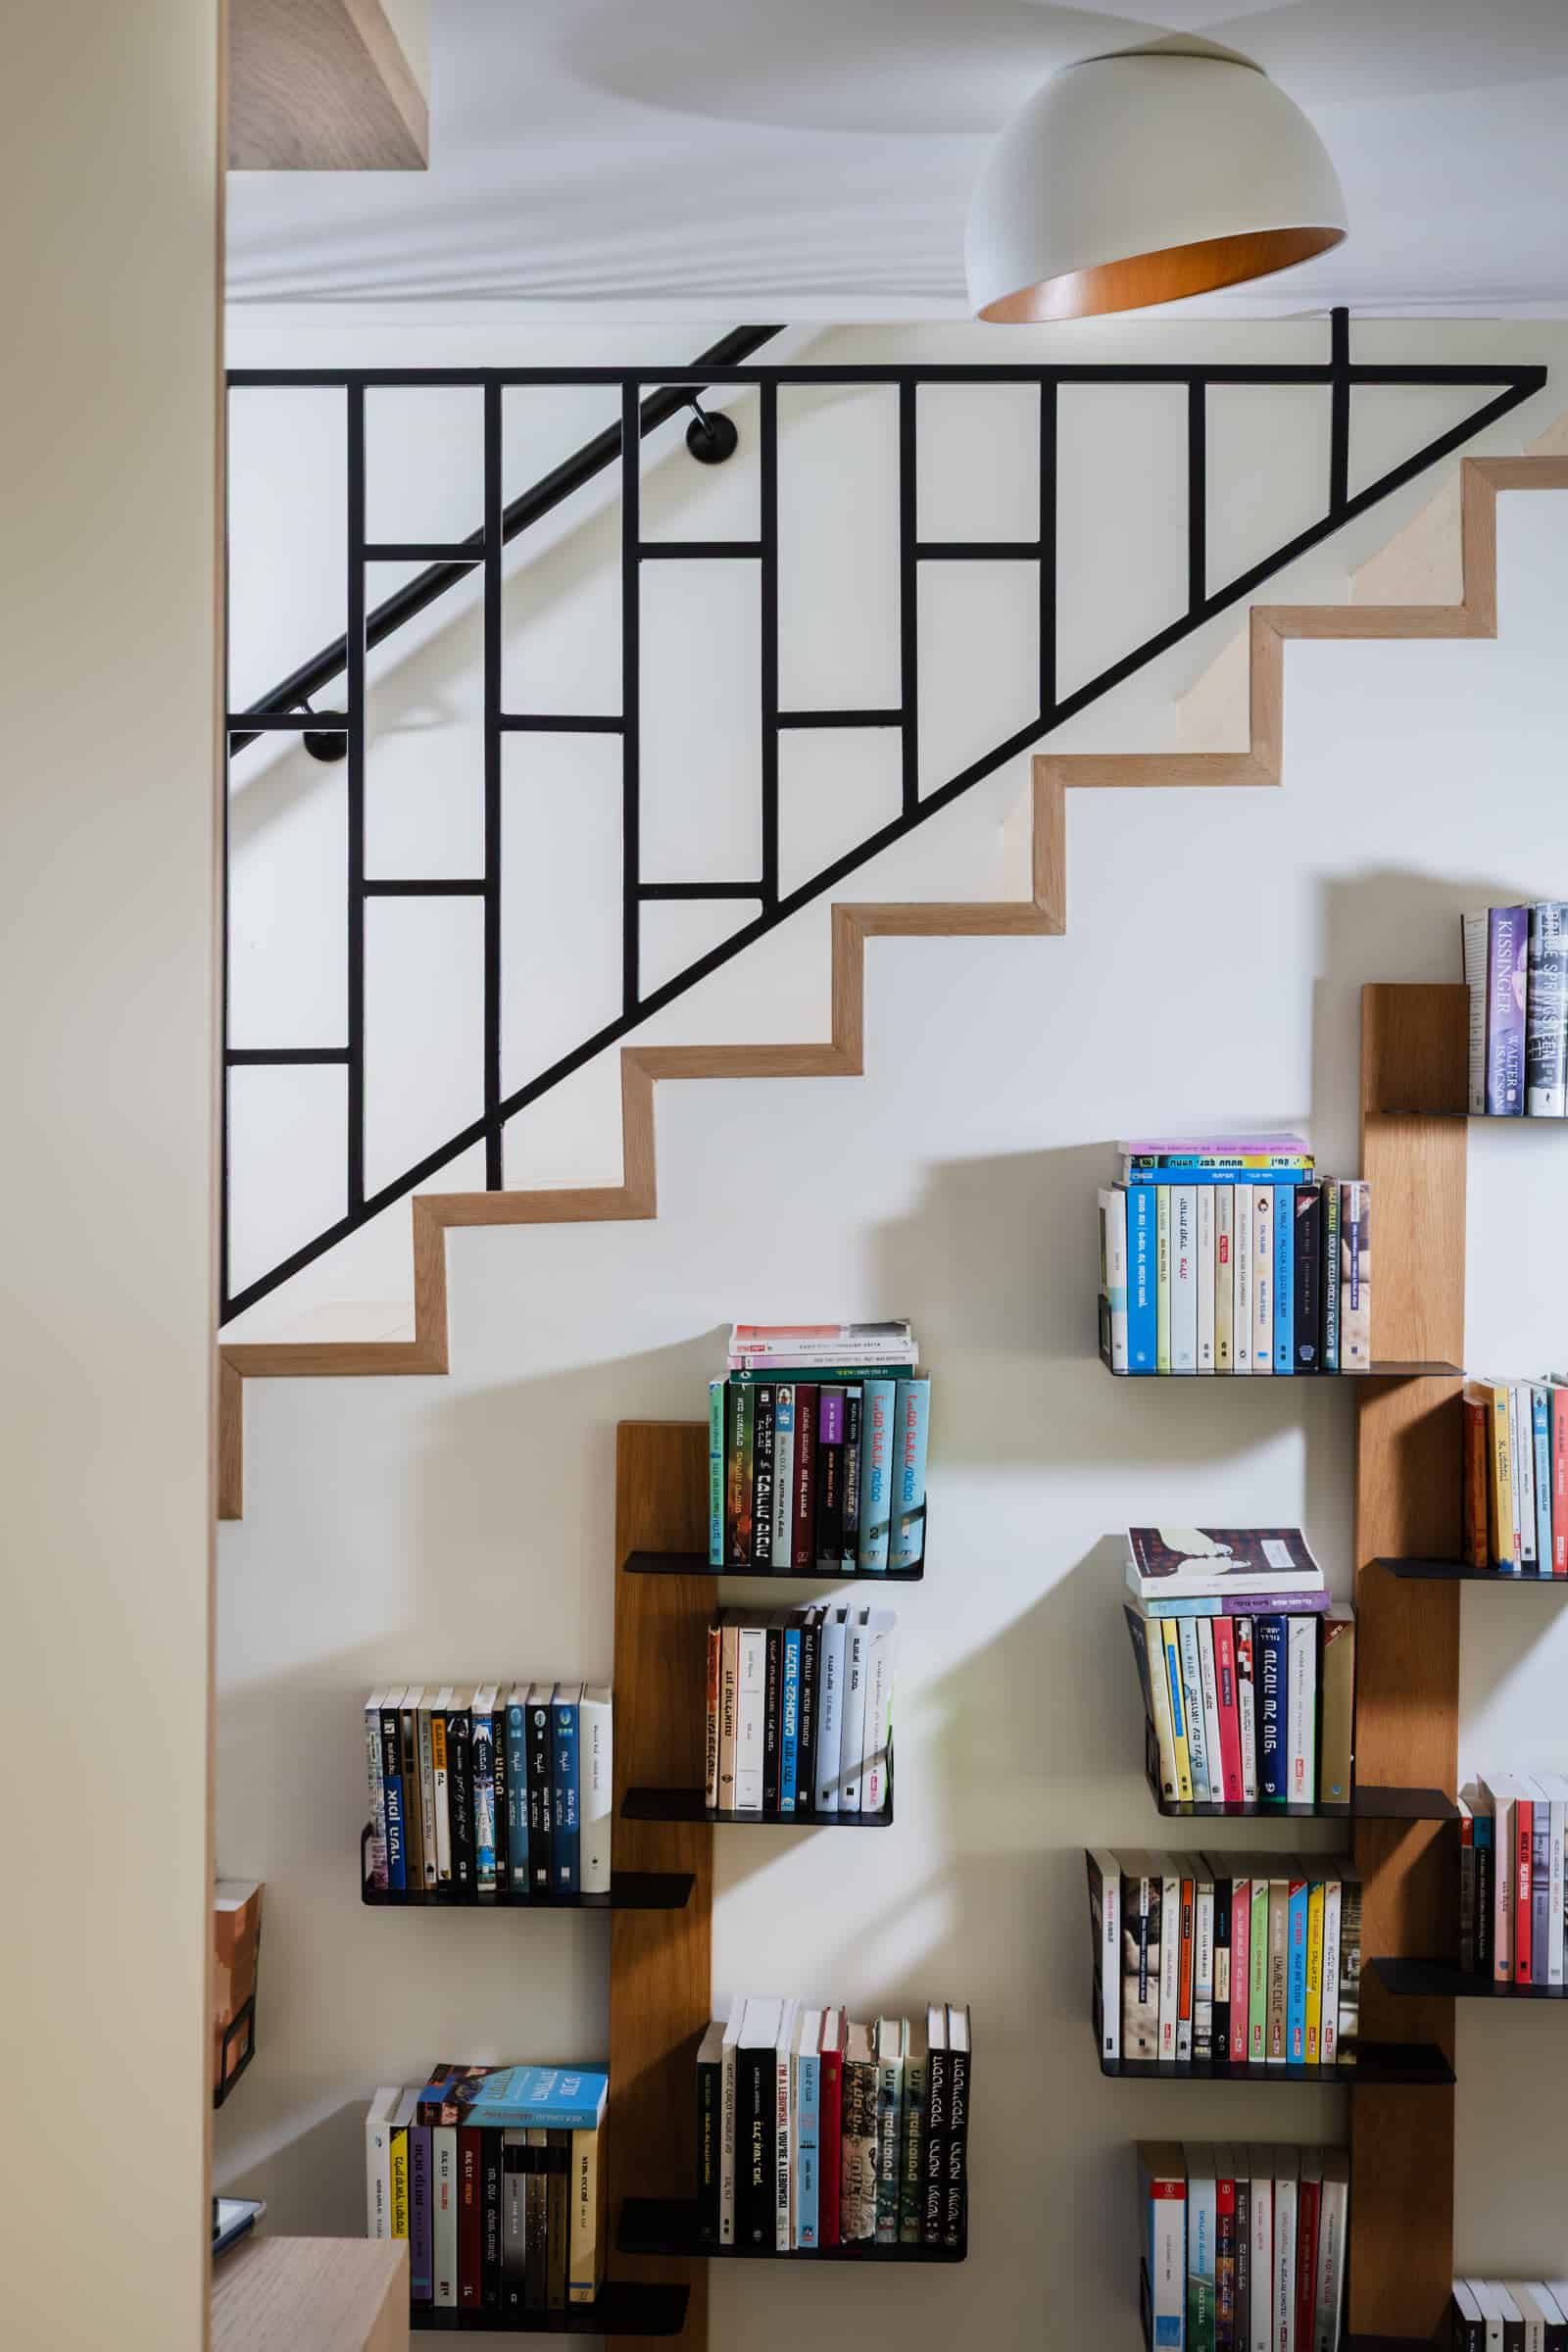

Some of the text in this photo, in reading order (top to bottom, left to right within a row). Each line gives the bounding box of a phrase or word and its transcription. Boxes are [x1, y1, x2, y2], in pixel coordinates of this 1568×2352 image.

[1496, 920, 1512, 1012] KISSINGER
[1543, 964, 1559, 1059] SPRINGSTEEN
[1495, 1046, 1506, 1108] ISAACSON
[1506, 1035, 1519, 1086] WALTER
[1179, 1199, 1189, 1250] יהודית קציר
[1179, 1258, 1188, 1279] צילה
[757, 1475, 770, 1557] בשורות טובות
[870, 1527, 878, 1539] 2
[1190, 1689, 1202, 1768] משוואה עם נעלם
[1262, 1649, 1277, 1755] עולמה של סופי
[388, 1789, 400, 1865] אומן השיר
[778, 2064, 788, 2078] I'M
[777, 2131, 788, 2159] YOU'RE
[884, 2112, 894, 2180] עמק הסוסים
[909, 2112, 919, 2180] עמק הסוסים
[928, 2056, 943, 2219] דוסטוייבסקי החטא ועונשו
[950, 2058, 963, 2221] דוסטוייבסקי החטא ועונשו
[777, 2169, 788, 2209] LEBOWSKI
[848, 2156, 862, 2230] שורשים
